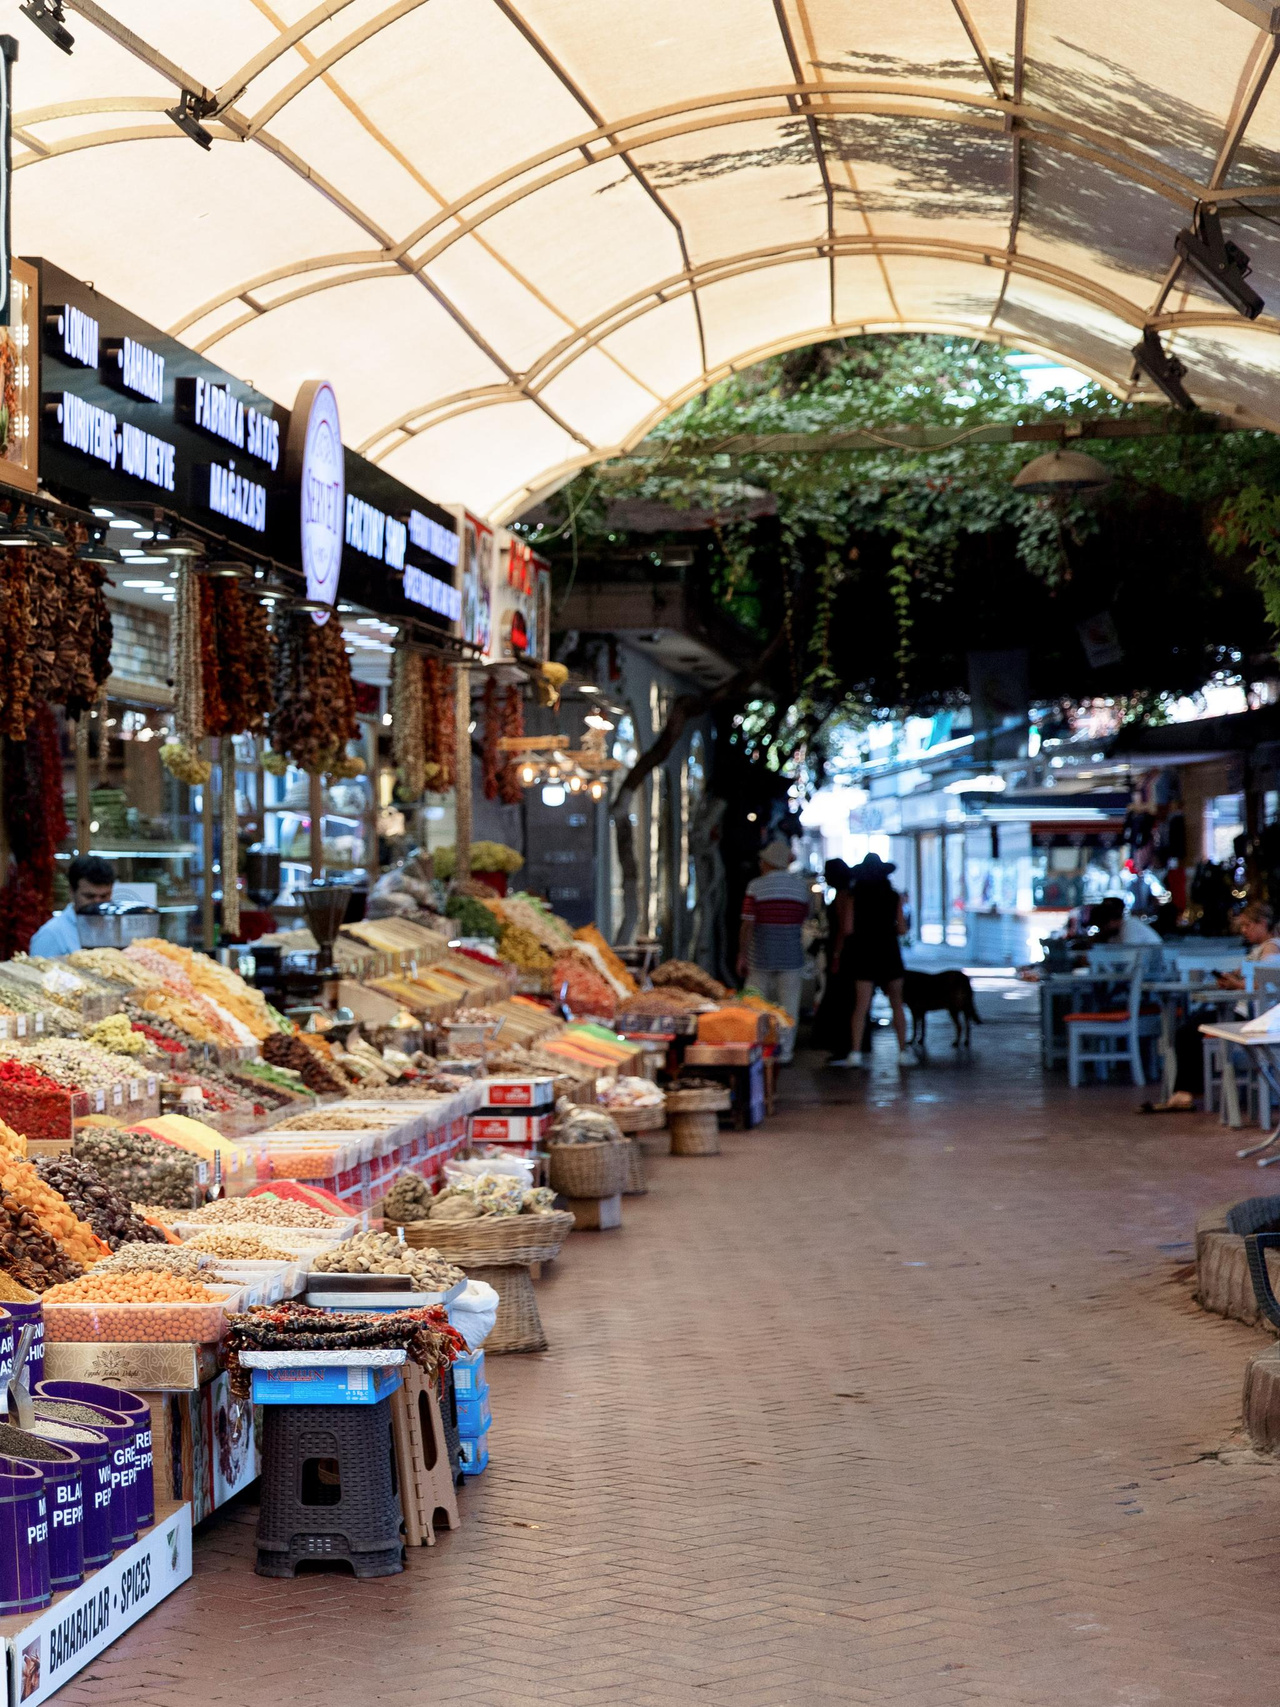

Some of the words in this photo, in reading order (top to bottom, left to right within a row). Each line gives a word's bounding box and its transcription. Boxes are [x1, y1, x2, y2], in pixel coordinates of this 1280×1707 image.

[64, 303, 98, 369] LOKUM
[123, 336, 165, 404] BAHARAT
[49, 1585, 110, 1675] BAHARATLAR
[121, 1552, 151, 1615] SPICES
